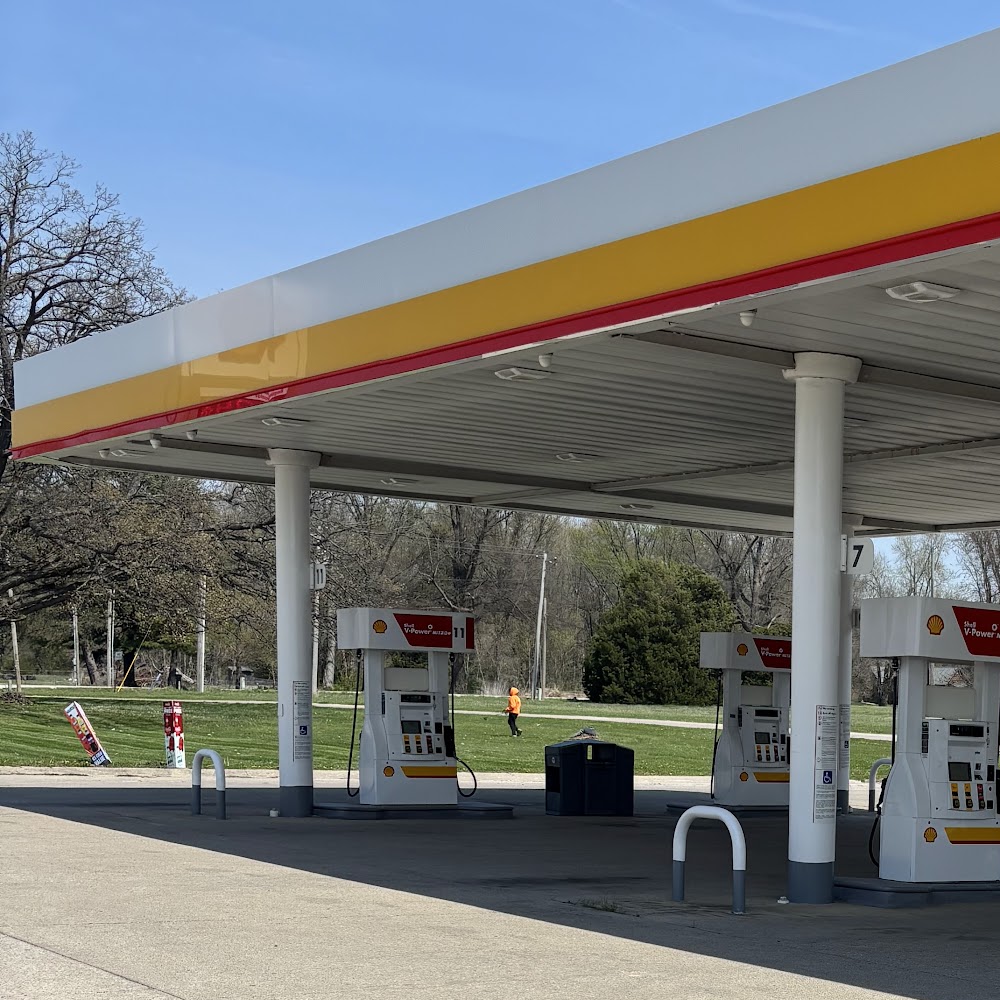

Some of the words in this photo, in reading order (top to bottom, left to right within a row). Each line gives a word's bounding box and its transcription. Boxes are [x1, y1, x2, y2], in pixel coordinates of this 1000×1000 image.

[852, 544, 864, 568] 7
[316, 568, 323, 585] 11
[403, 627, 432, 635] V-Power
[453, 627, 465, 638] 11
[964, 628, 995, 638] V-Power
